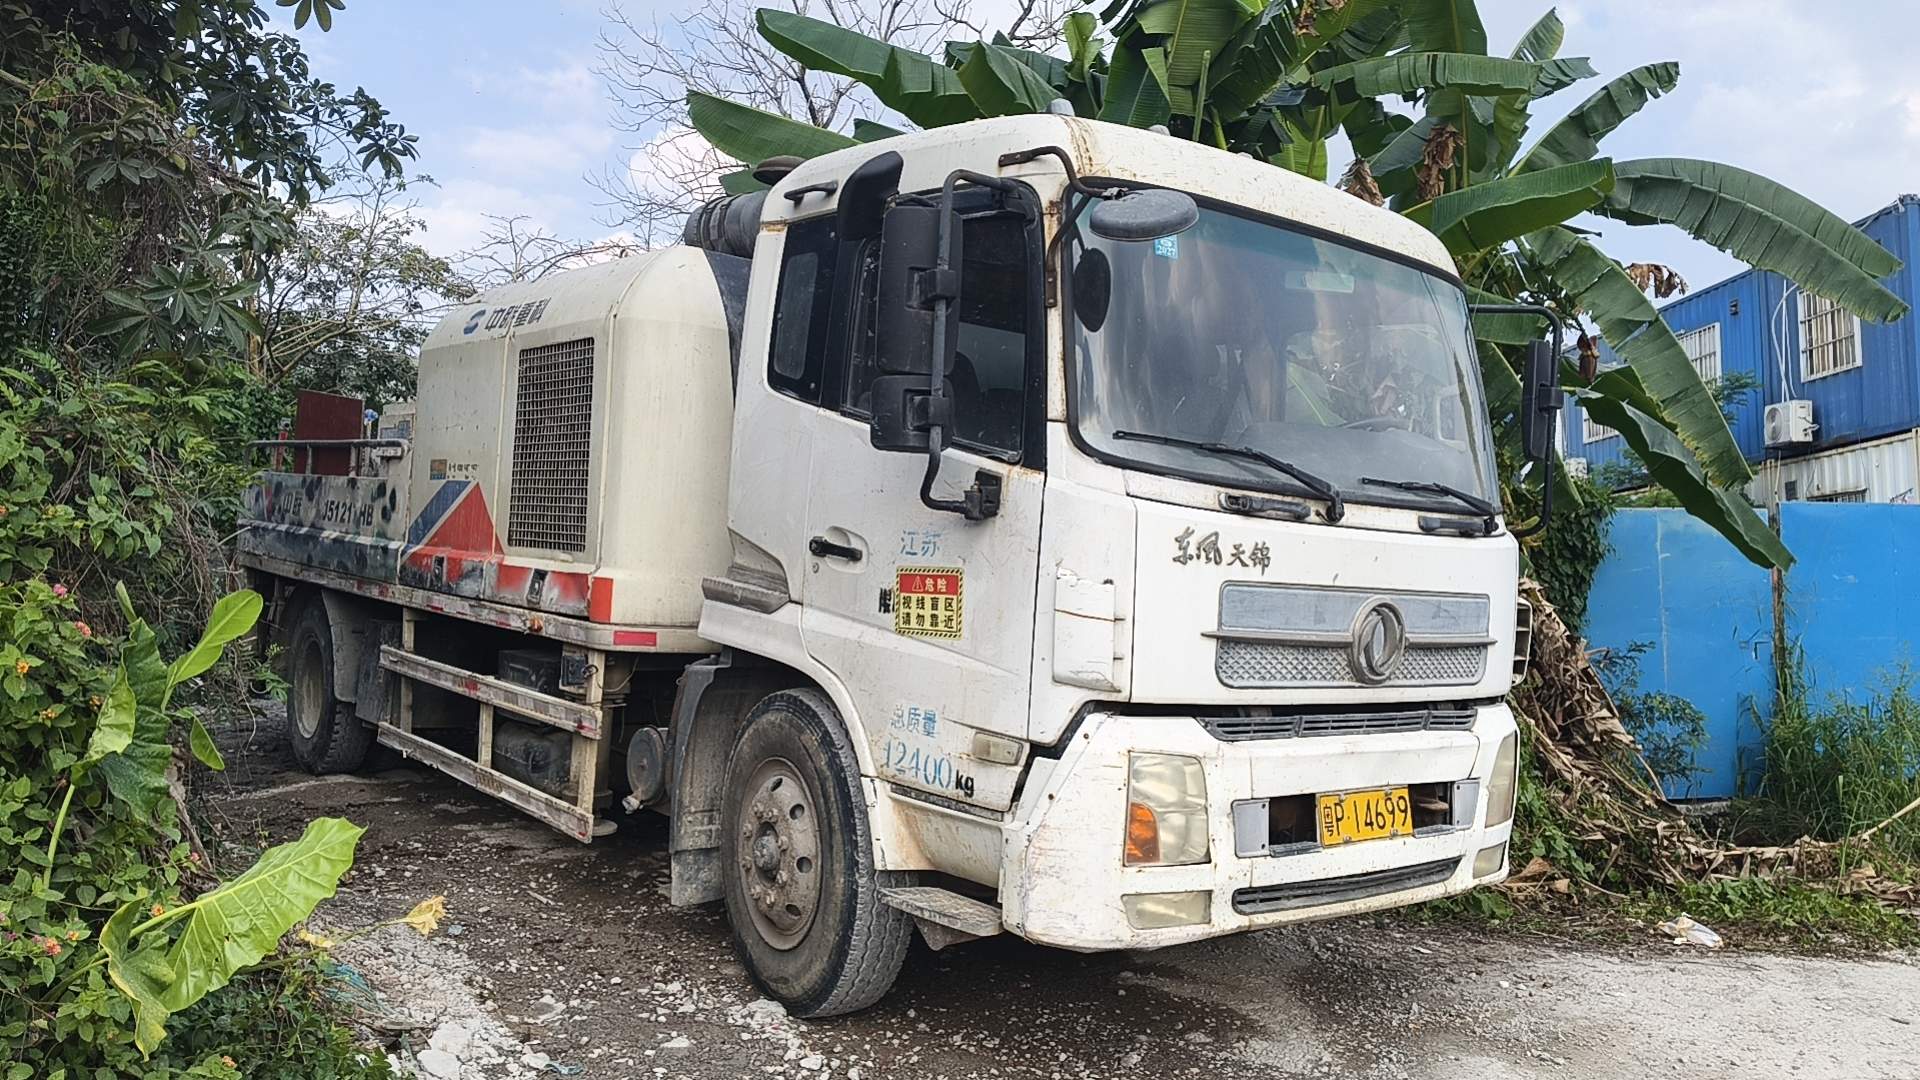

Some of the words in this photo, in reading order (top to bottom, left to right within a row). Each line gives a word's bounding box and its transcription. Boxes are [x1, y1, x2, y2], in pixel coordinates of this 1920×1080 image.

[900, 529, 942, 557] 江苏
[924, 577, 948, 593] 危险
[902, 595, 955, 612] 视线盲区
[902, 612, 955, 629] 请勿靠近
[890, 703, 937, 739] 总质量
